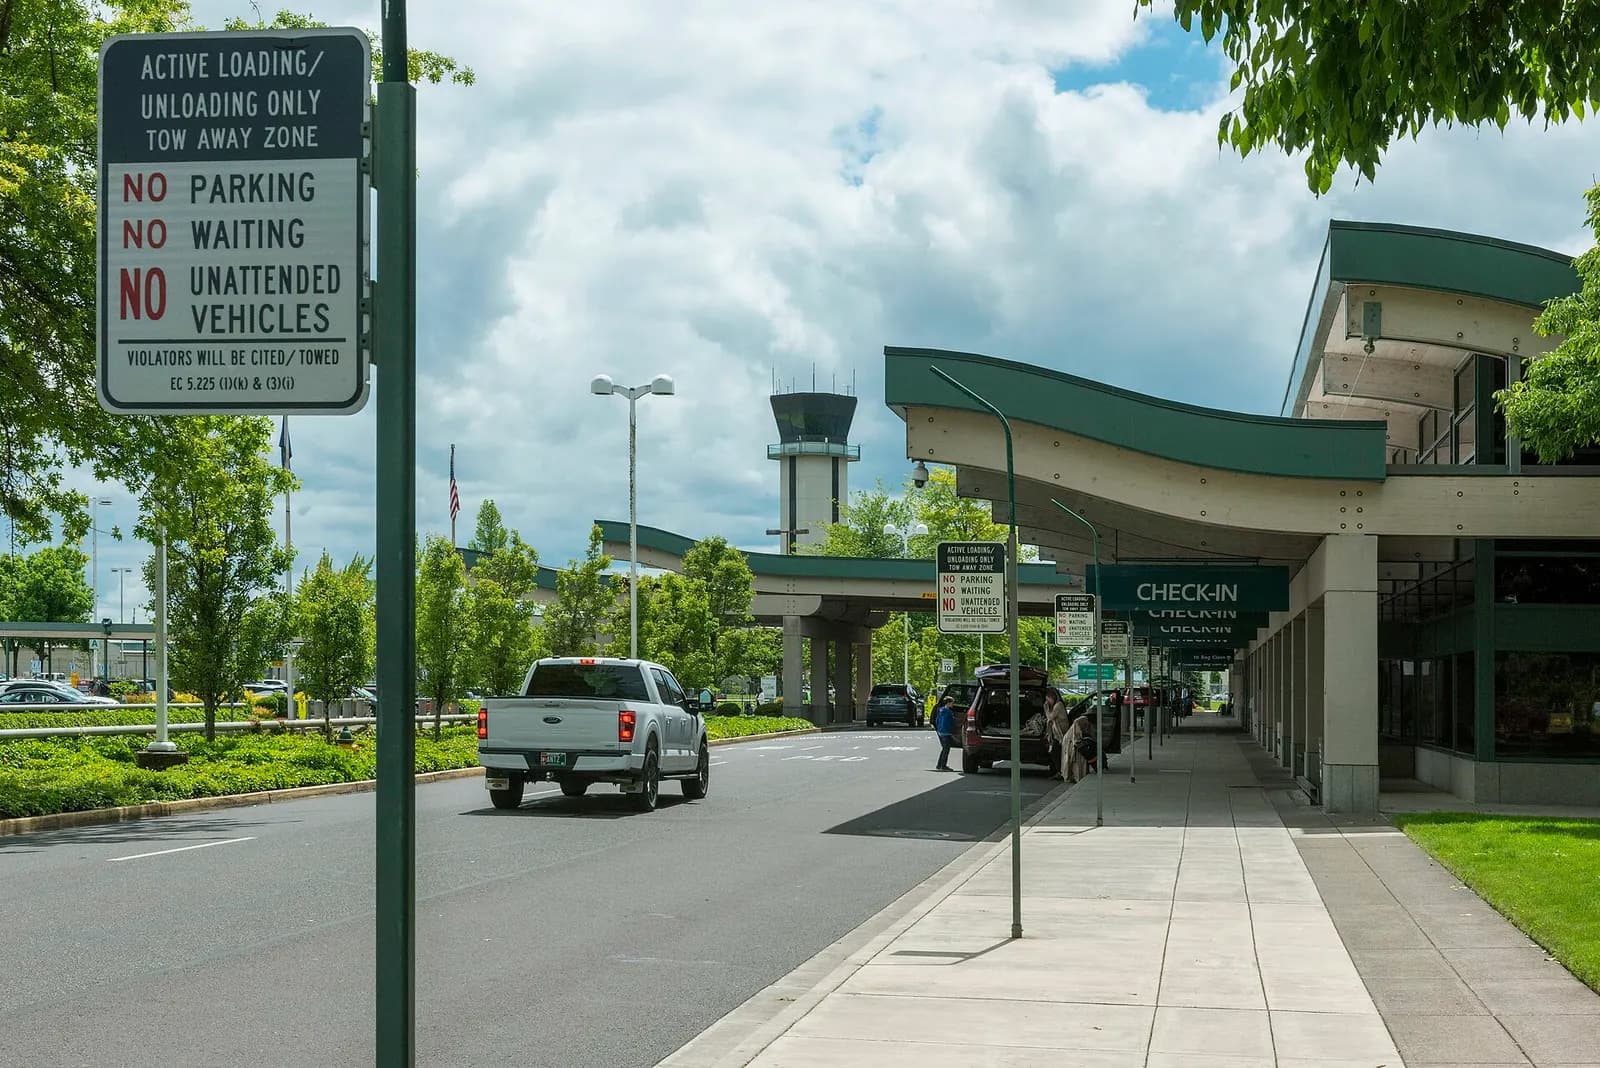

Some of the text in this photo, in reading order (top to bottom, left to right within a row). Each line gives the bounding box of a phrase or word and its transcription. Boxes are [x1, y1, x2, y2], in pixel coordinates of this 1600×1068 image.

[141, 50, 324, 80] ACTIVE LOADING/
[142, 89, 321, 119] UNLOADING ONLY
[146, 126, 318, 151] TOW AWAY ZONE
[123, 172, 315, 204] NO PARKING
[123, 218, 304, 249] NO WAITING
[120, 264, 341, 321] NO UNATTENDED
[191, 303, 330, 335] VEHICLES
[127, 350, 192, 366] VIOLATORS
[197, 349, 226, 366] WILL
[231, 349, 246, 366] BE
[170, 376, 183, 391] EC
[187, 376, 215, 391] 5.225
[252, 376, 262, 391] &
[947, 546, 965, 554] ACTIVE
[943, 575, 994, 584] NO PARKING
[943, 586, 991, 595] NO WAITING
[1136, 583, 1238, 602] CHECK-IN
[943, 598, 1000, 611] NO UNATTENDED
[961, 607, 998, 615] VEHICLES
